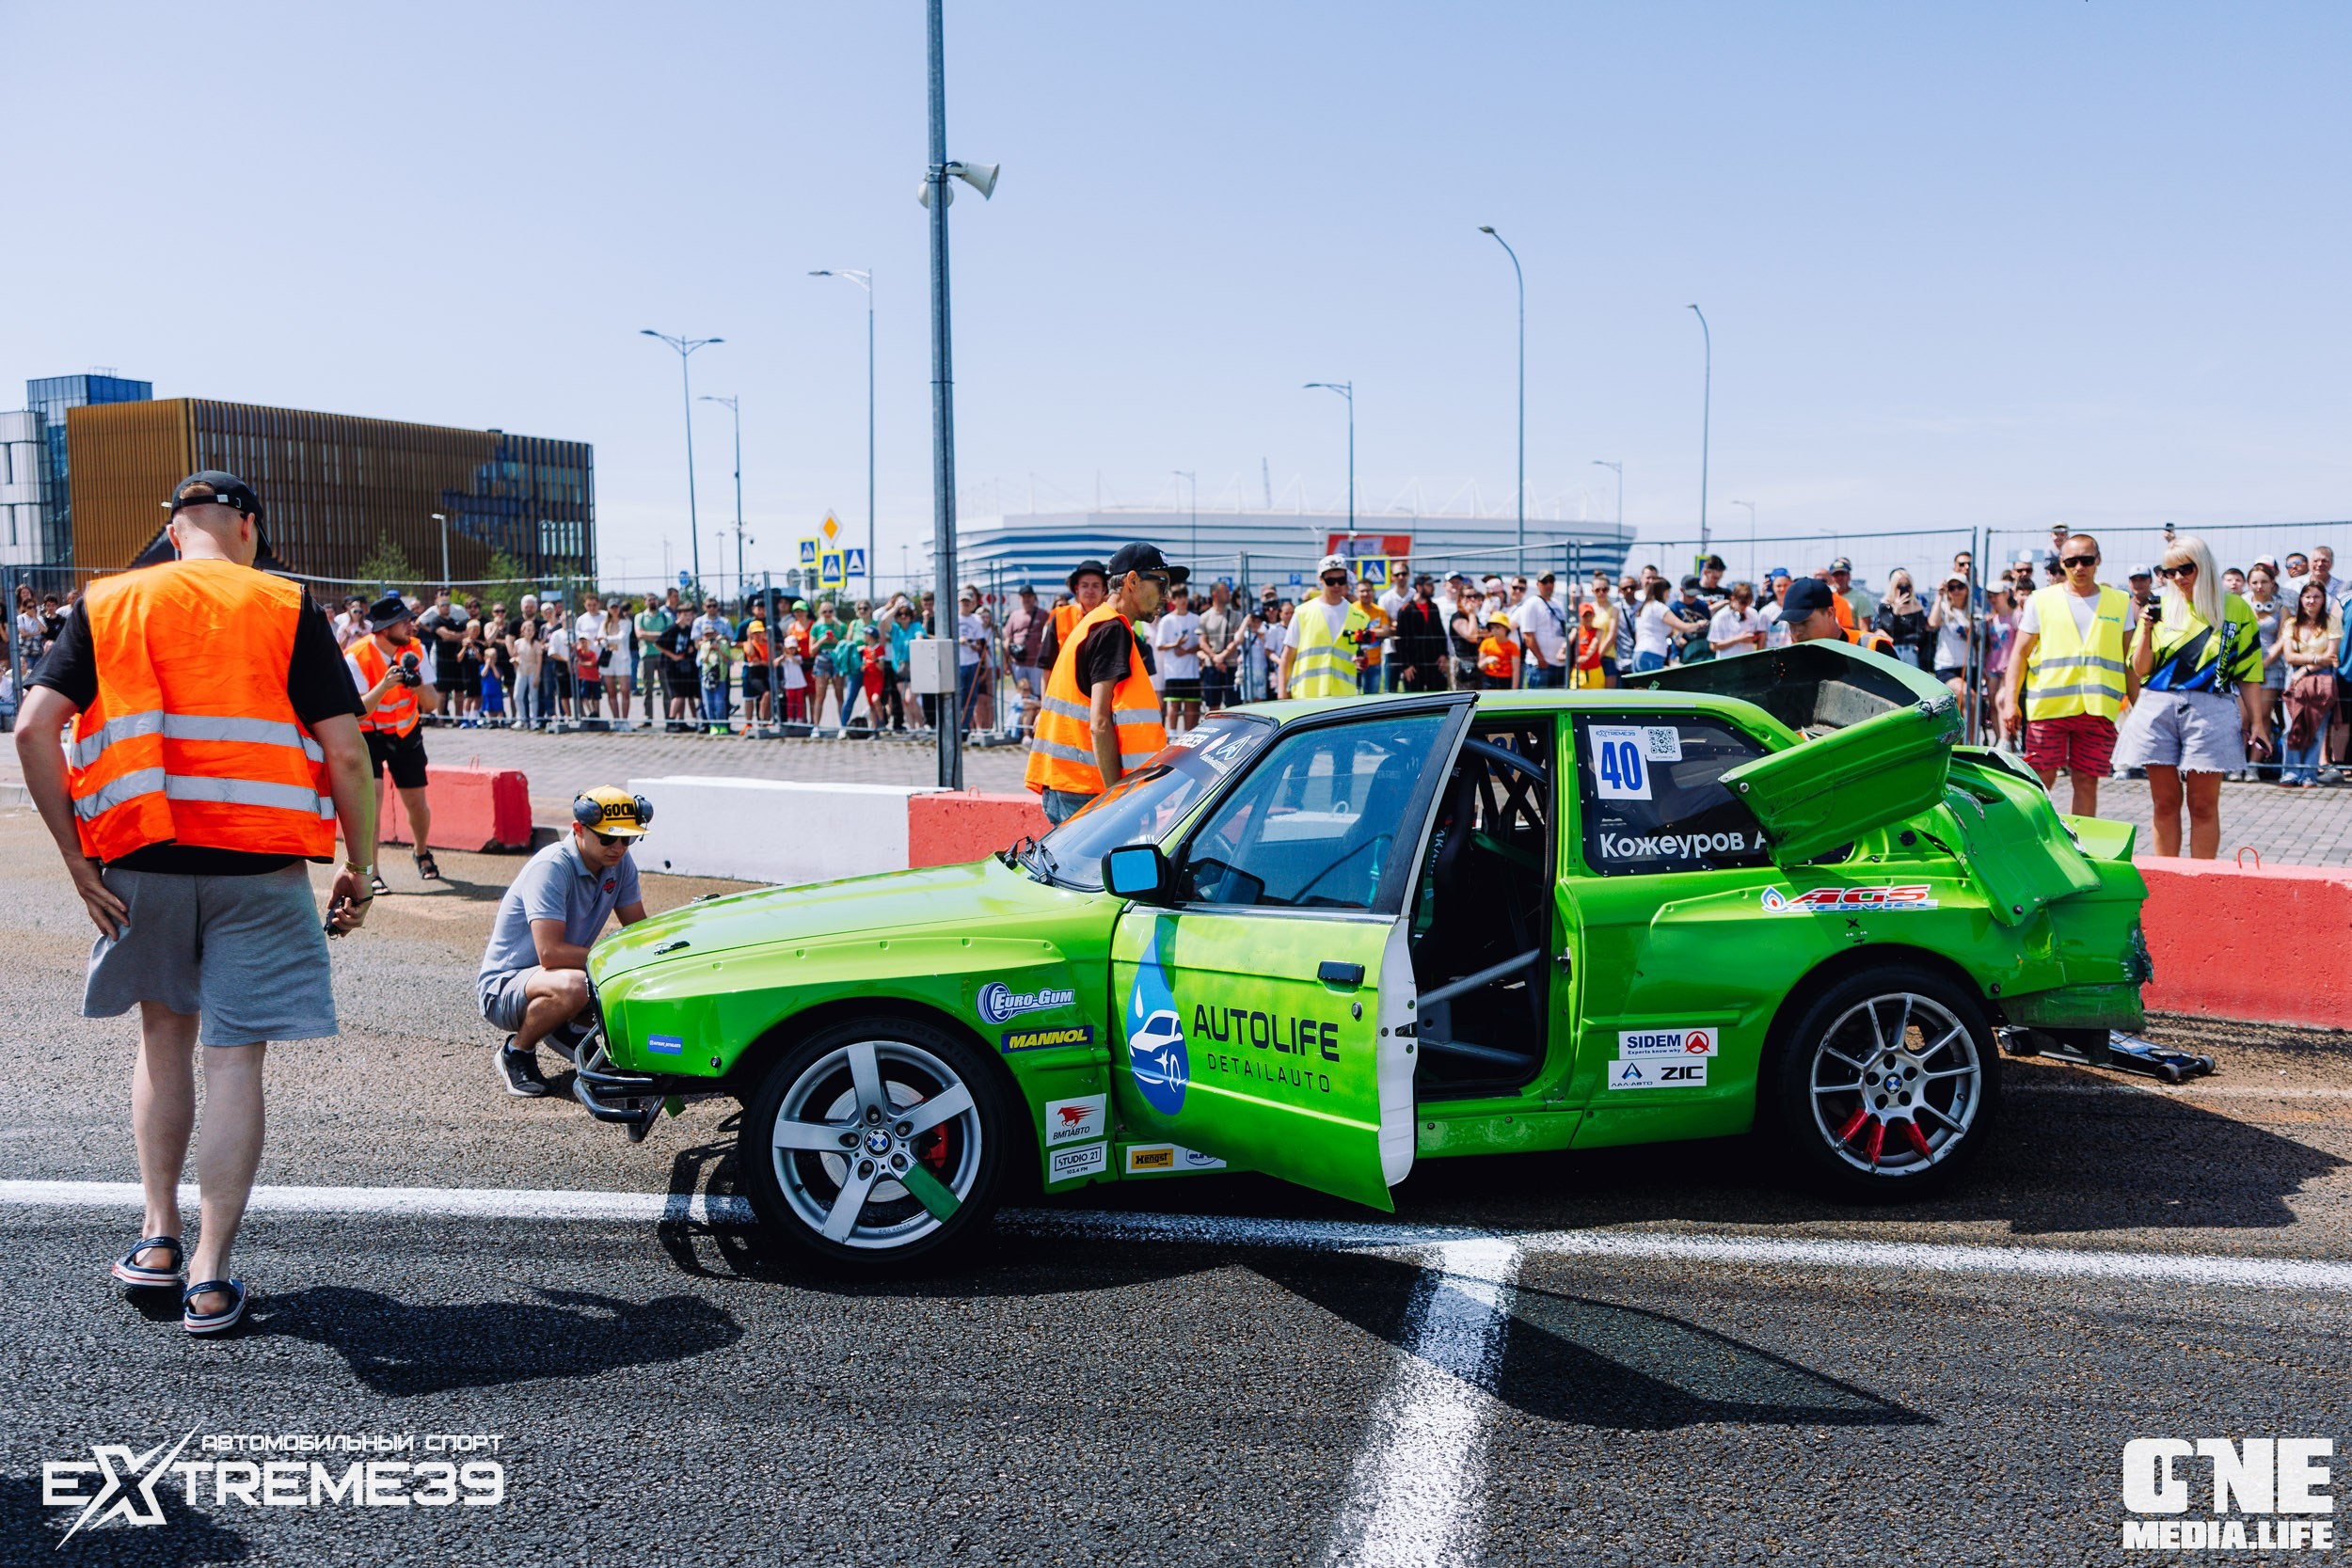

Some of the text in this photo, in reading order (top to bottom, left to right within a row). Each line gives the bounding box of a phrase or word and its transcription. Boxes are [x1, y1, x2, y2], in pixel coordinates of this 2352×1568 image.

[1600, 741, 1643, 791] 40
[1600, 832, 1745, 859] Кожеуров
[1791, 885, 1931, 904] AGS
[1795, 901, 1937, 911] SERVICE
[1009, 1029, 1088, 1049] MANNOL
[1193, 1004, 1340, 1062] AUTOLIFE
[1627, 1034, 1681, 1049] SIDEM
[1207, 1053, 1330, 1093] DETAILAUTO
[1661, 1066, 1703, 1081] ZIC
[1053, 1126, 1090, 1140] ВМПАВТО
[1058, 1150, 1099, 1166] STUDIO 21
[1136, 1152, 1168, 1164] Hengst
